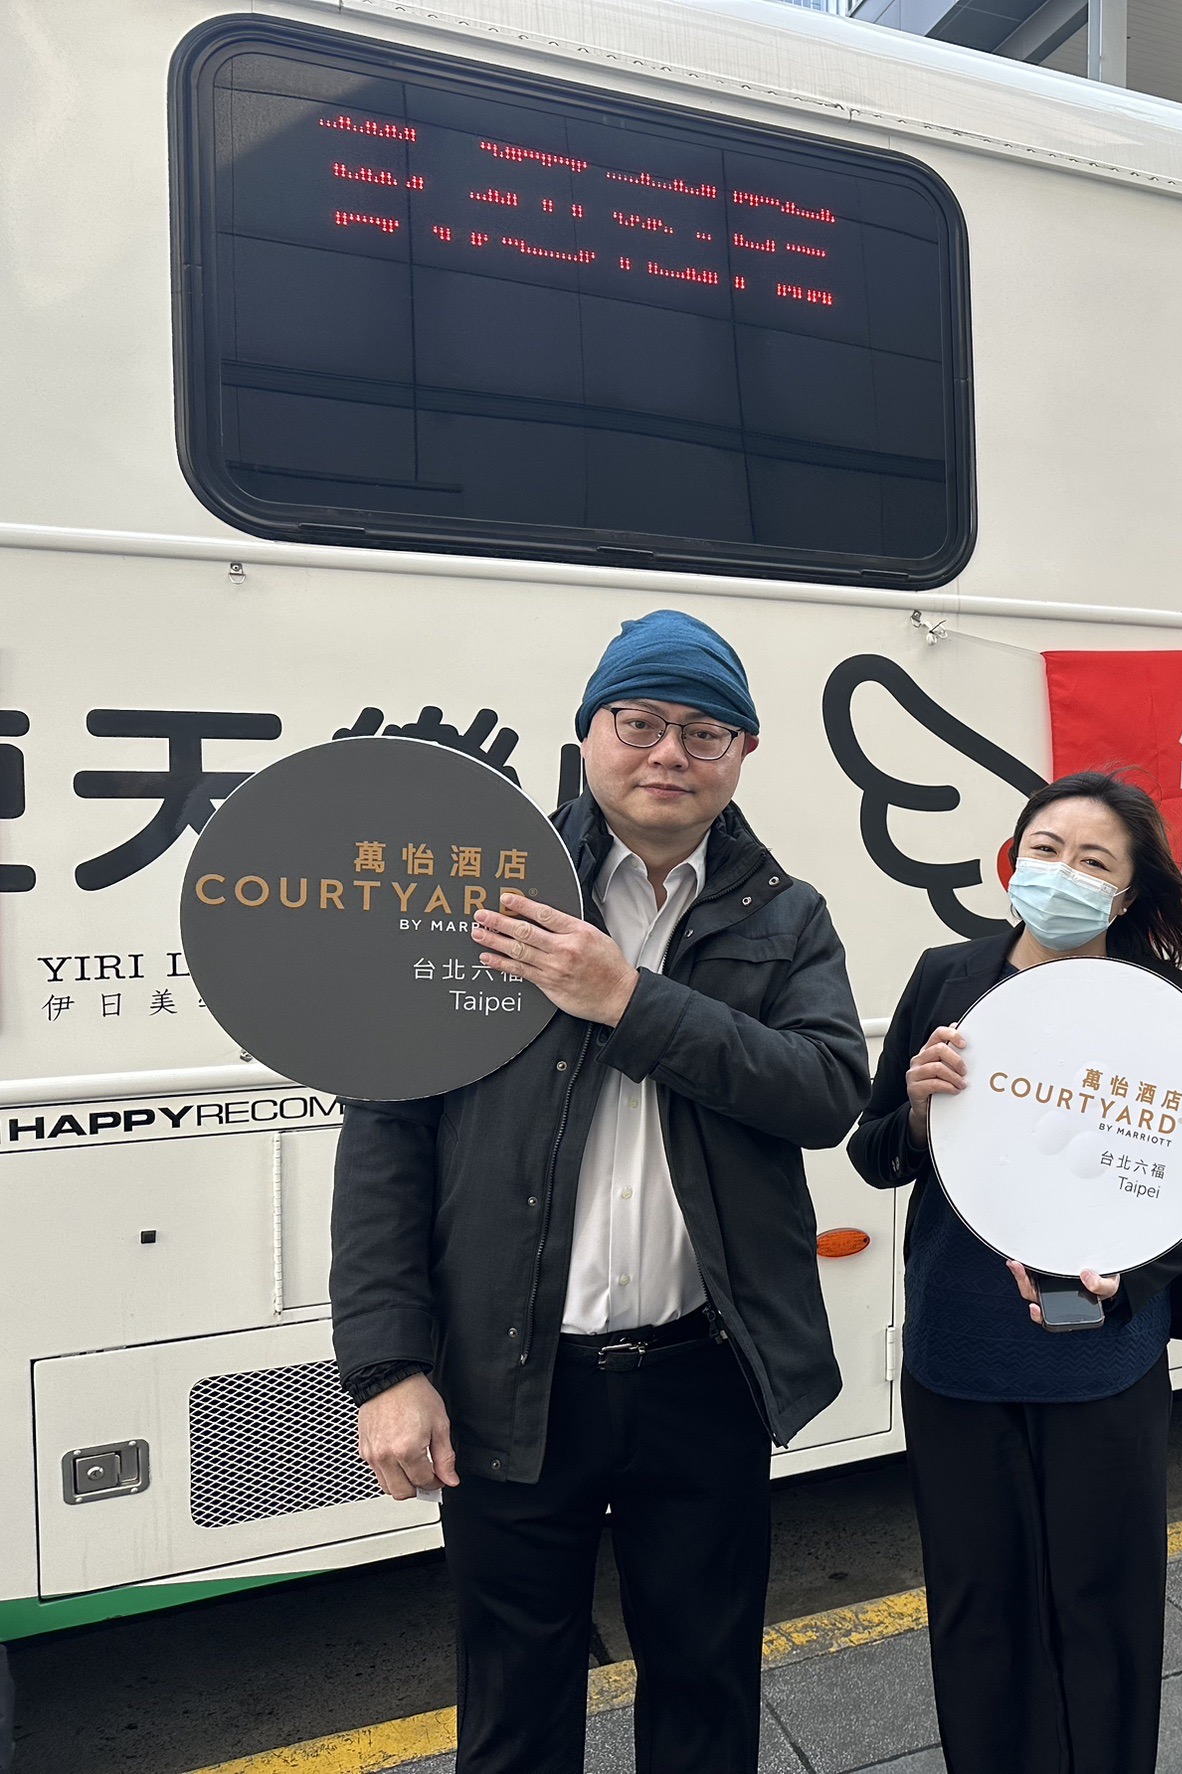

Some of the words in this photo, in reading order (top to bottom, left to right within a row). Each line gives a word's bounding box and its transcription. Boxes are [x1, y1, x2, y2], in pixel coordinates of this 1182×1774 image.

[354, 840, 529, 880] 萬怡酒店
[399, 919, 423, 931] BY
[37, 953, 145, 983] YIRI
[449, 989, 522, 1016] Taipei
[989, 1072, 1178, 1135] COURTYARD
[1099, 1122, 1113, 1132] BY
[1116, 1127, 1173, 1148] MARRIOTT
[1100, 1150, 1167, 1180] 台北六福
[1118, 1175, 1161, 1199] Taipei
